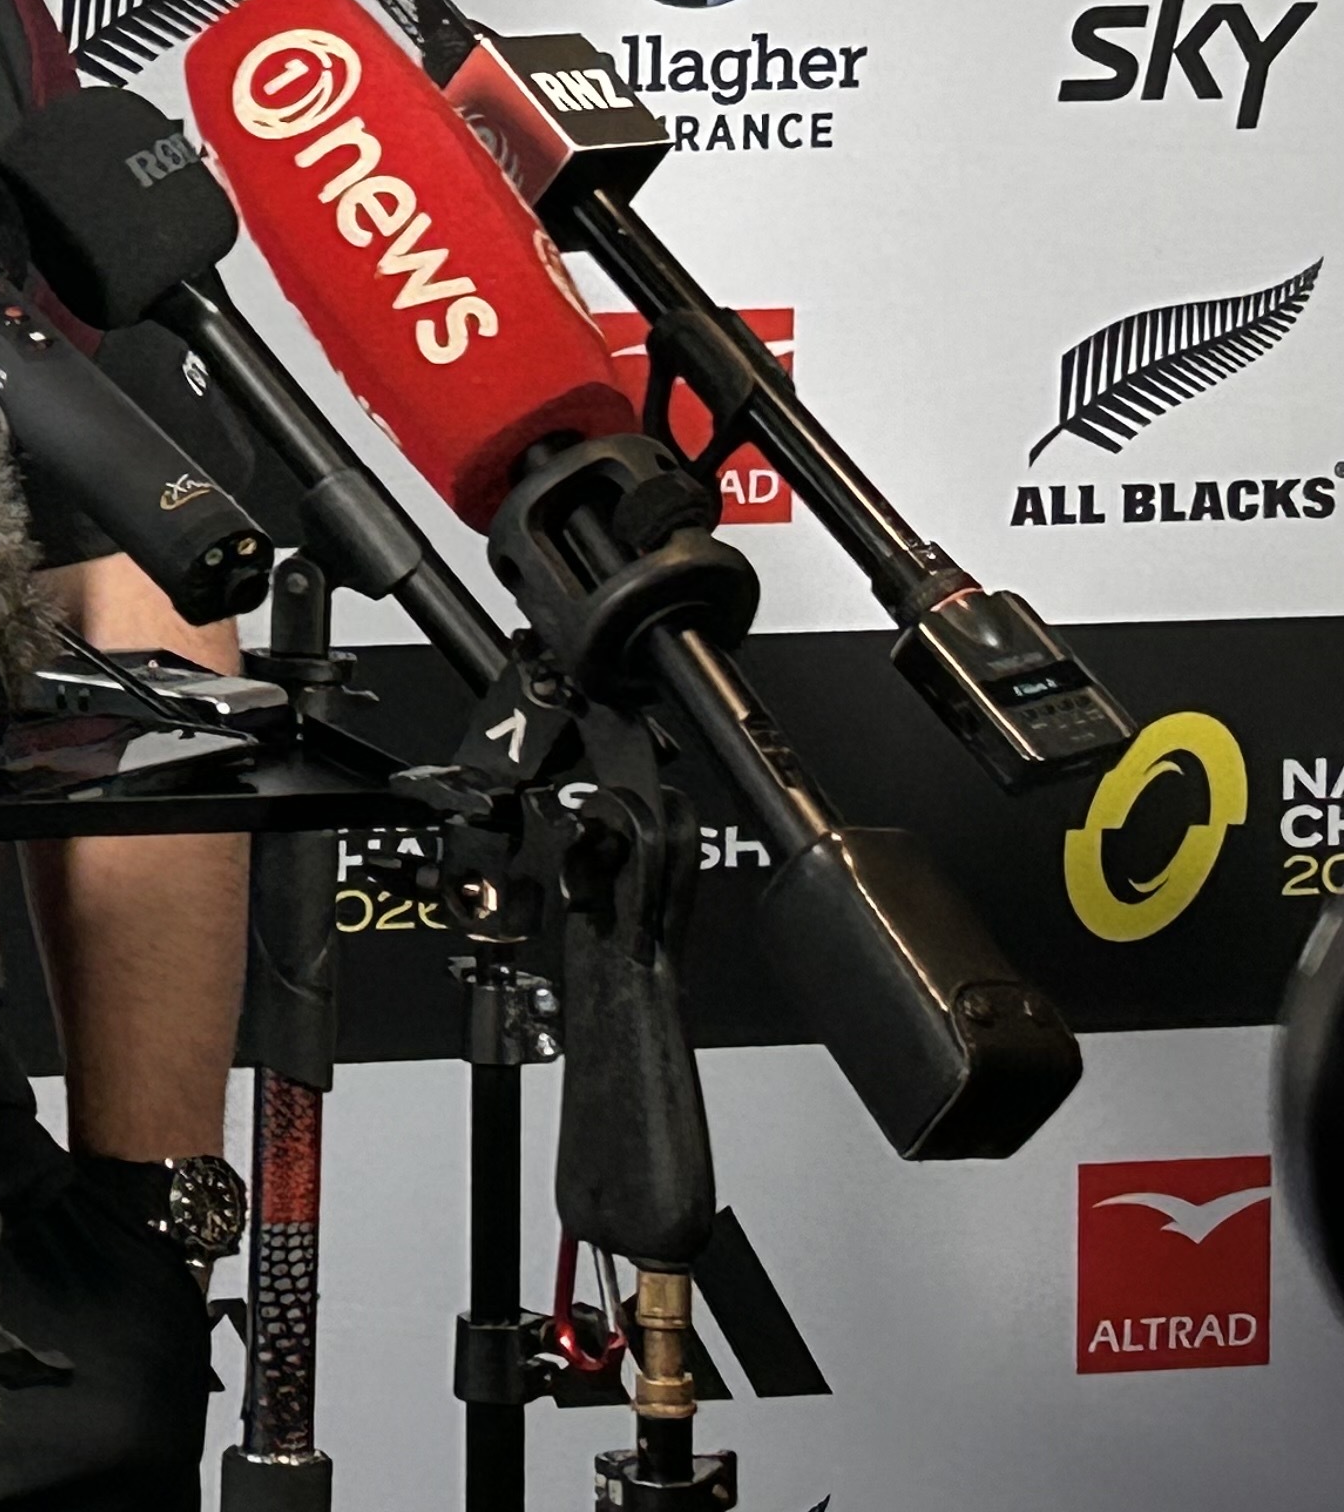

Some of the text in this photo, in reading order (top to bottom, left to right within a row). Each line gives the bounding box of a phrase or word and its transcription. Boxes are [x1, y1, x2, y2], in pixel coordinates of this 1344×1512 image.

[530, 68, 634, 112] RNZ
[621, 33, 868, 105] llagher
[674, 112, 833, 152] RANCE
[293, 115, 499, 365] news
[1010, 476, 1336, 527] ALL BLACKS
[1087, 1313, 1257, 1353] ALTRAD
